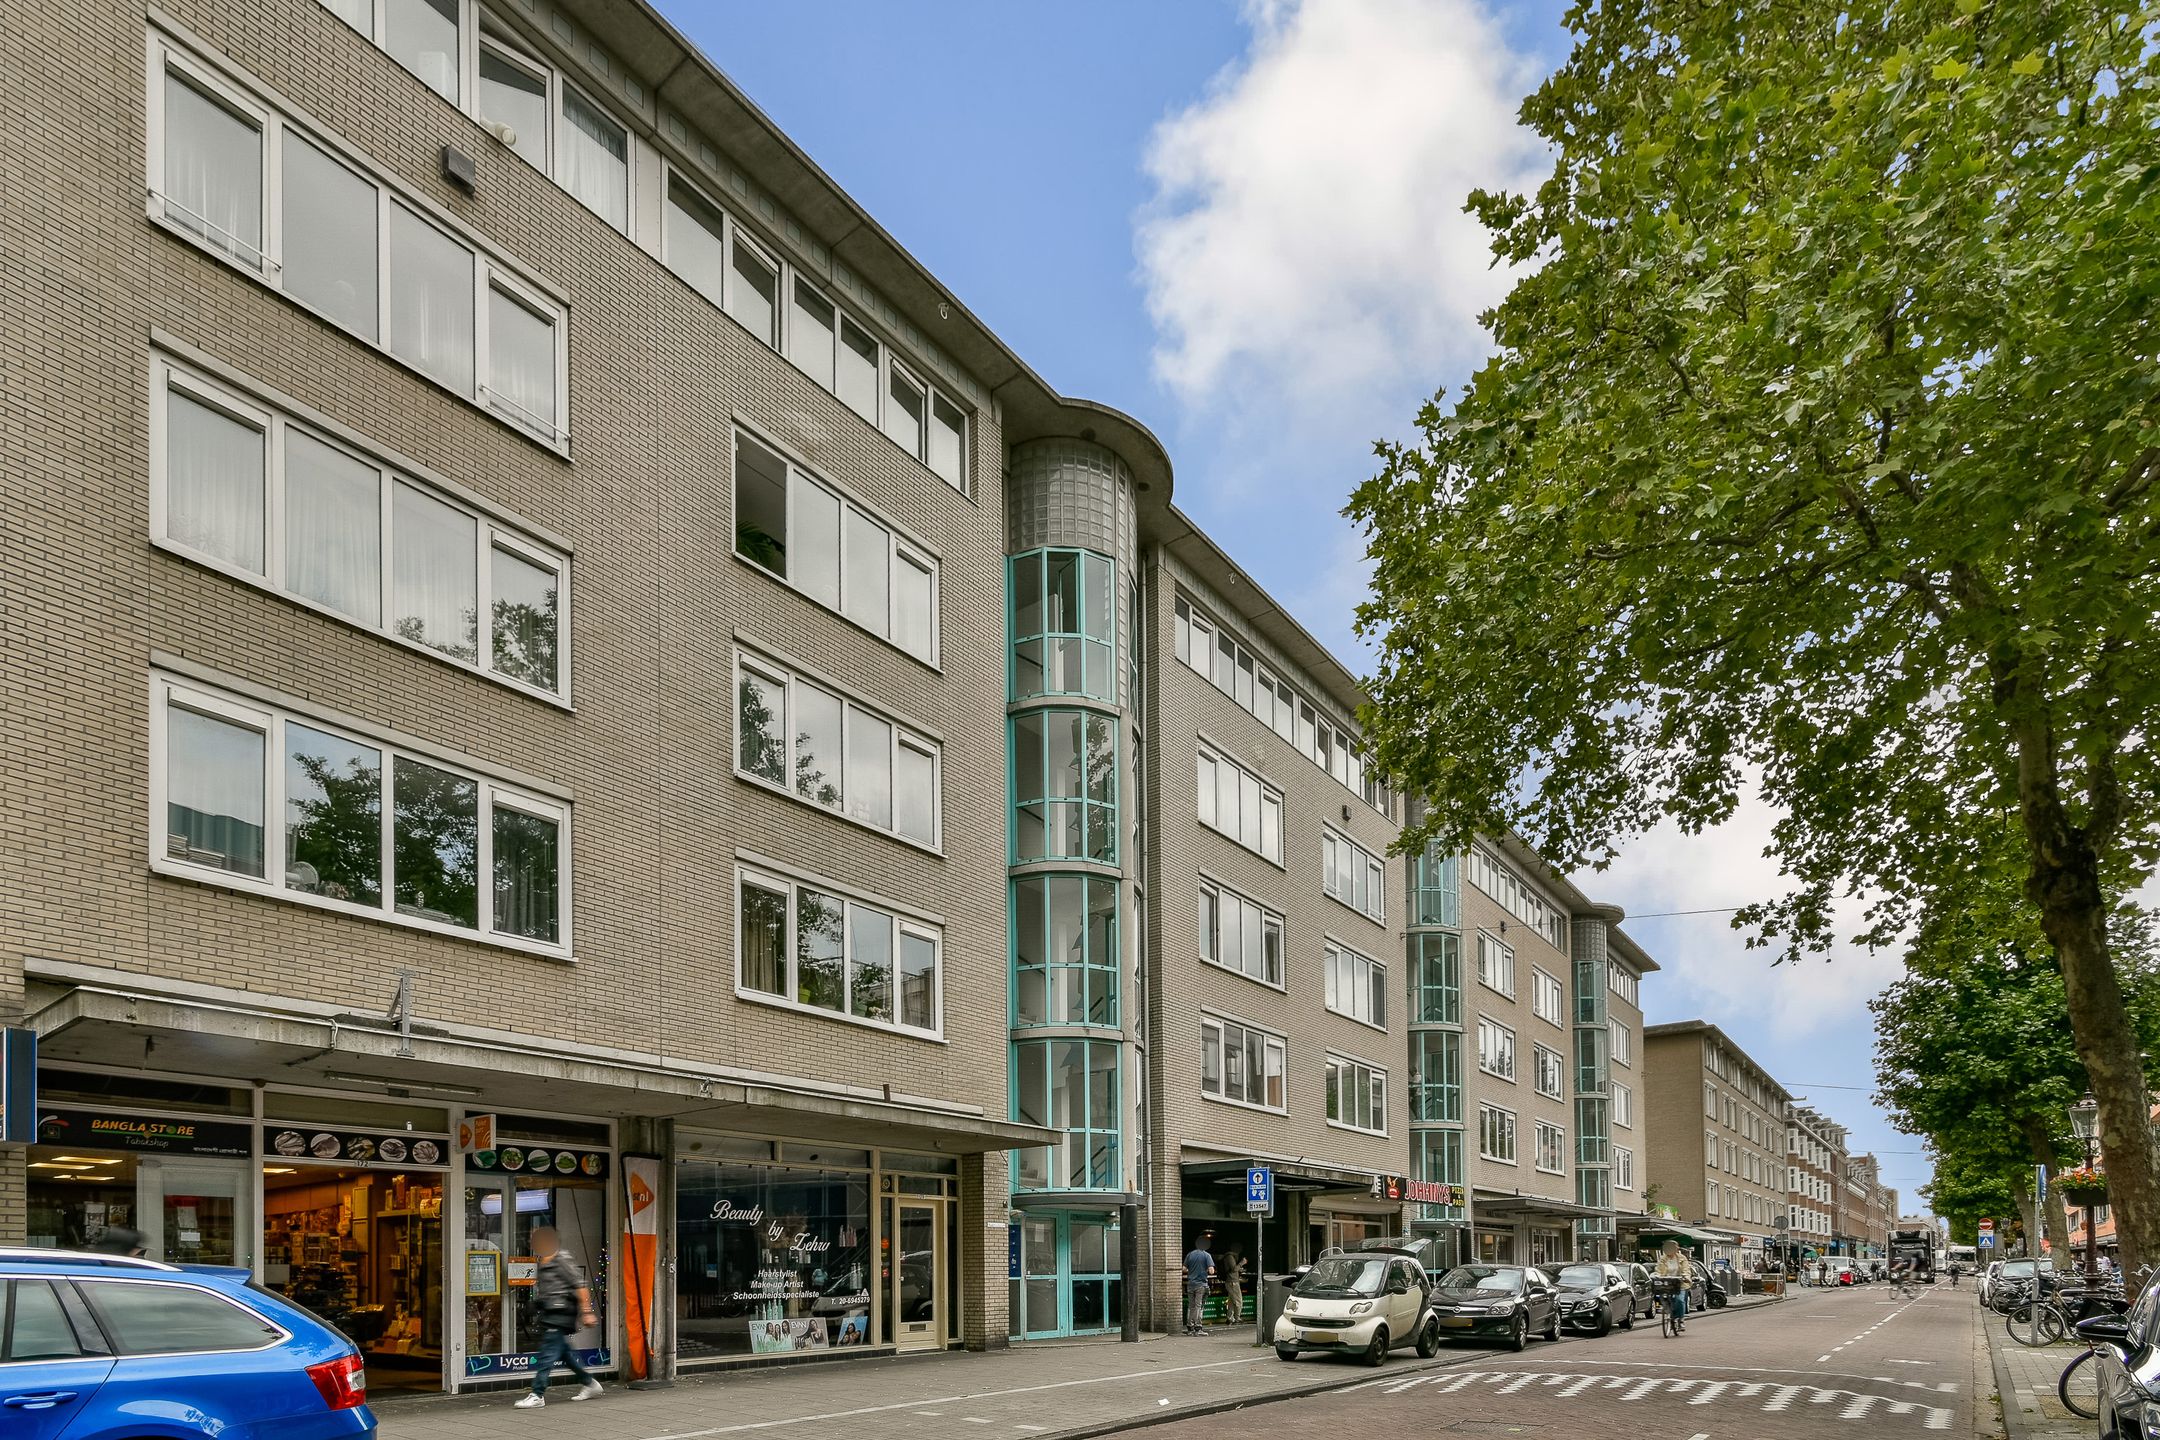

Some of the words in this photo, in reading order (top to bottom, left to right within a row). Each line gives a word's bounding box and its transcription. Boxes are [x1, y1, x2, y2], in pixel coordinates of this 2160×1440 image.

[91, 1119, 146, 1133] BANGLA
[149, 1123, 195, 1136] STORE
[125, 1135, 169, 1148] Tabakshop
[710, 1199, 763, 1226] Beauty
[768, 1220, 784, 1241] by
[757, 1269, 798, 1279] Haarstylist
[750, 1280, 783, 1289] Make-up
[784, 1280, 804, 1288] Artist
[733, 1290, 820, 1301] Schoonheidsspecialiste
[500, 1356, 529, 1368] Lyca
